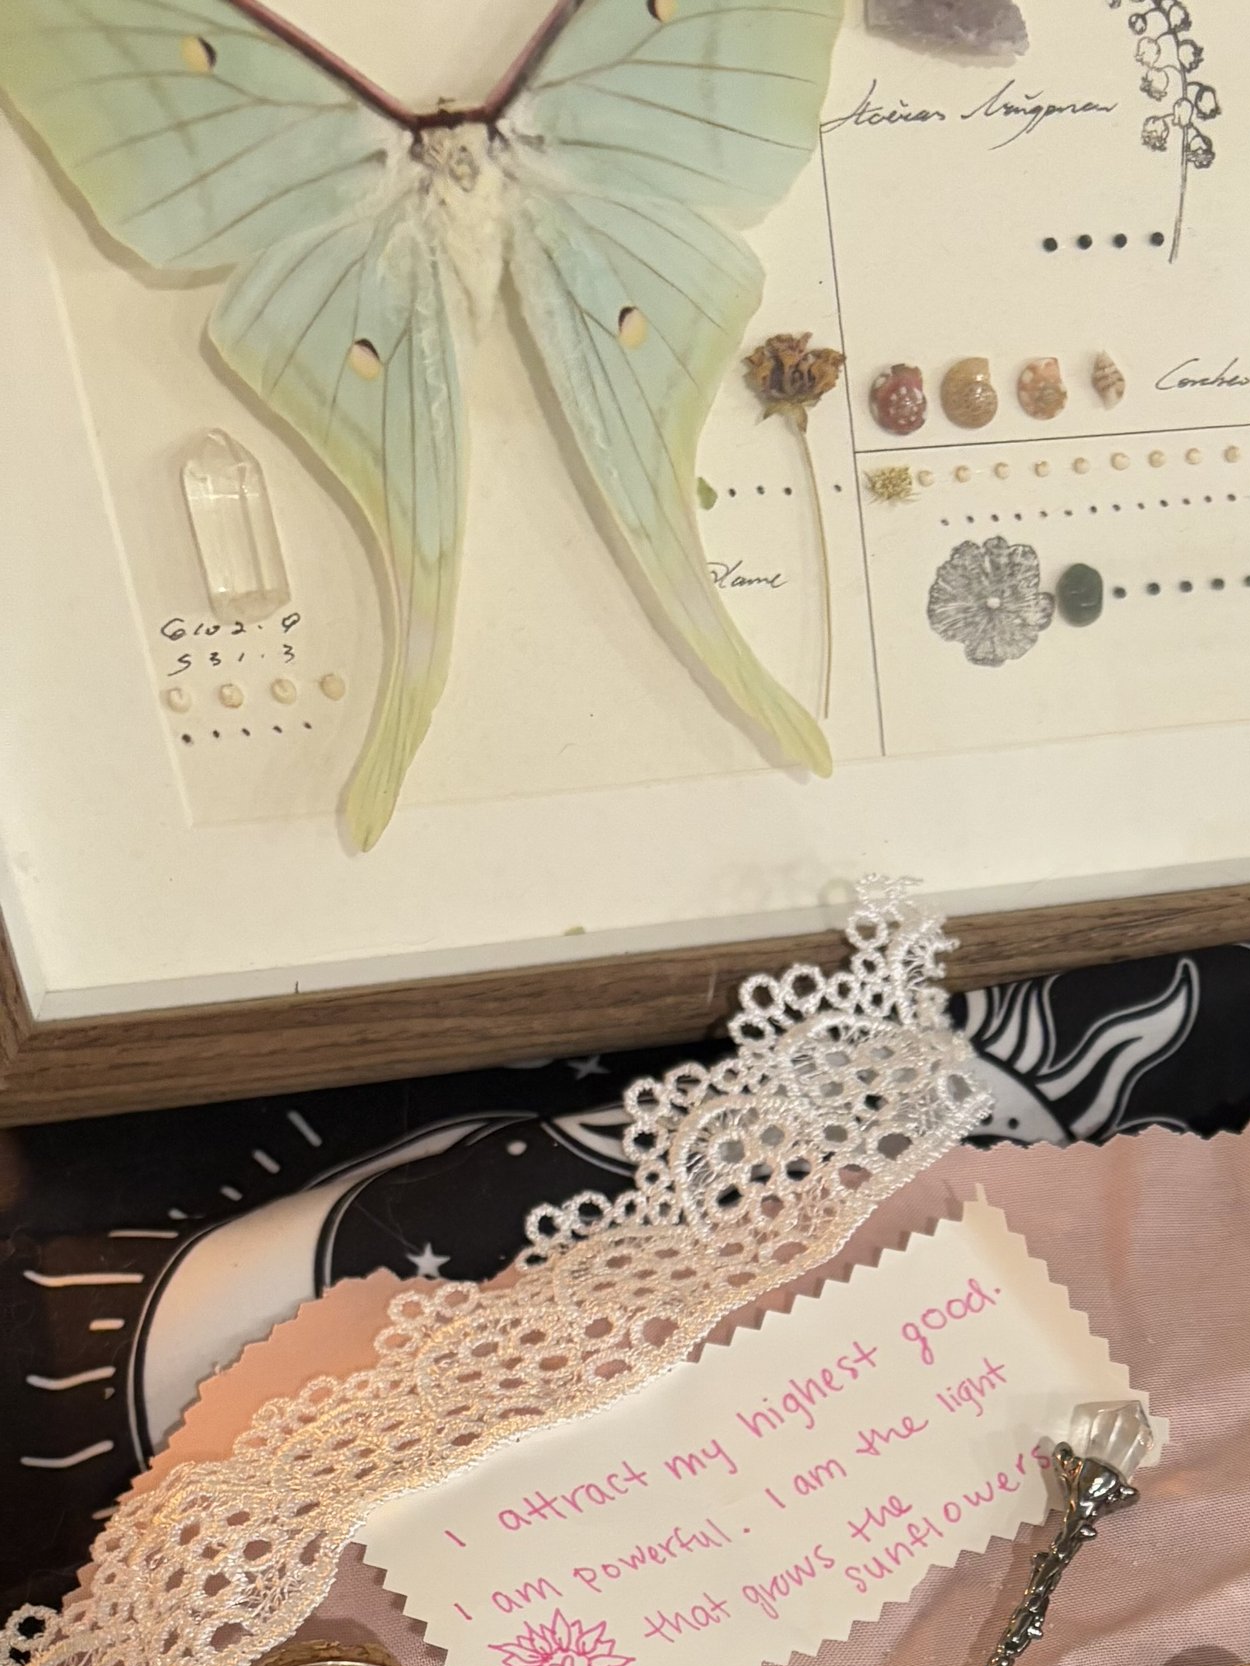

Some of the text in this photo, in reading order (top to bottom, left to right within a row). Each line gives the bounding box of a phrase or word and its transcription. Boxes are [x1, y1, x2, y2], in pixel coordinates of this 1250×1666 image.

[444, 1278, 1002, 1547] I attract my highest good.
[454, 1356, 1007, 1621] I am powerful. I am the light
[643, 1494, 913, 1643] that grows the
[844, 1443, 1052, 1593] sunflowers
